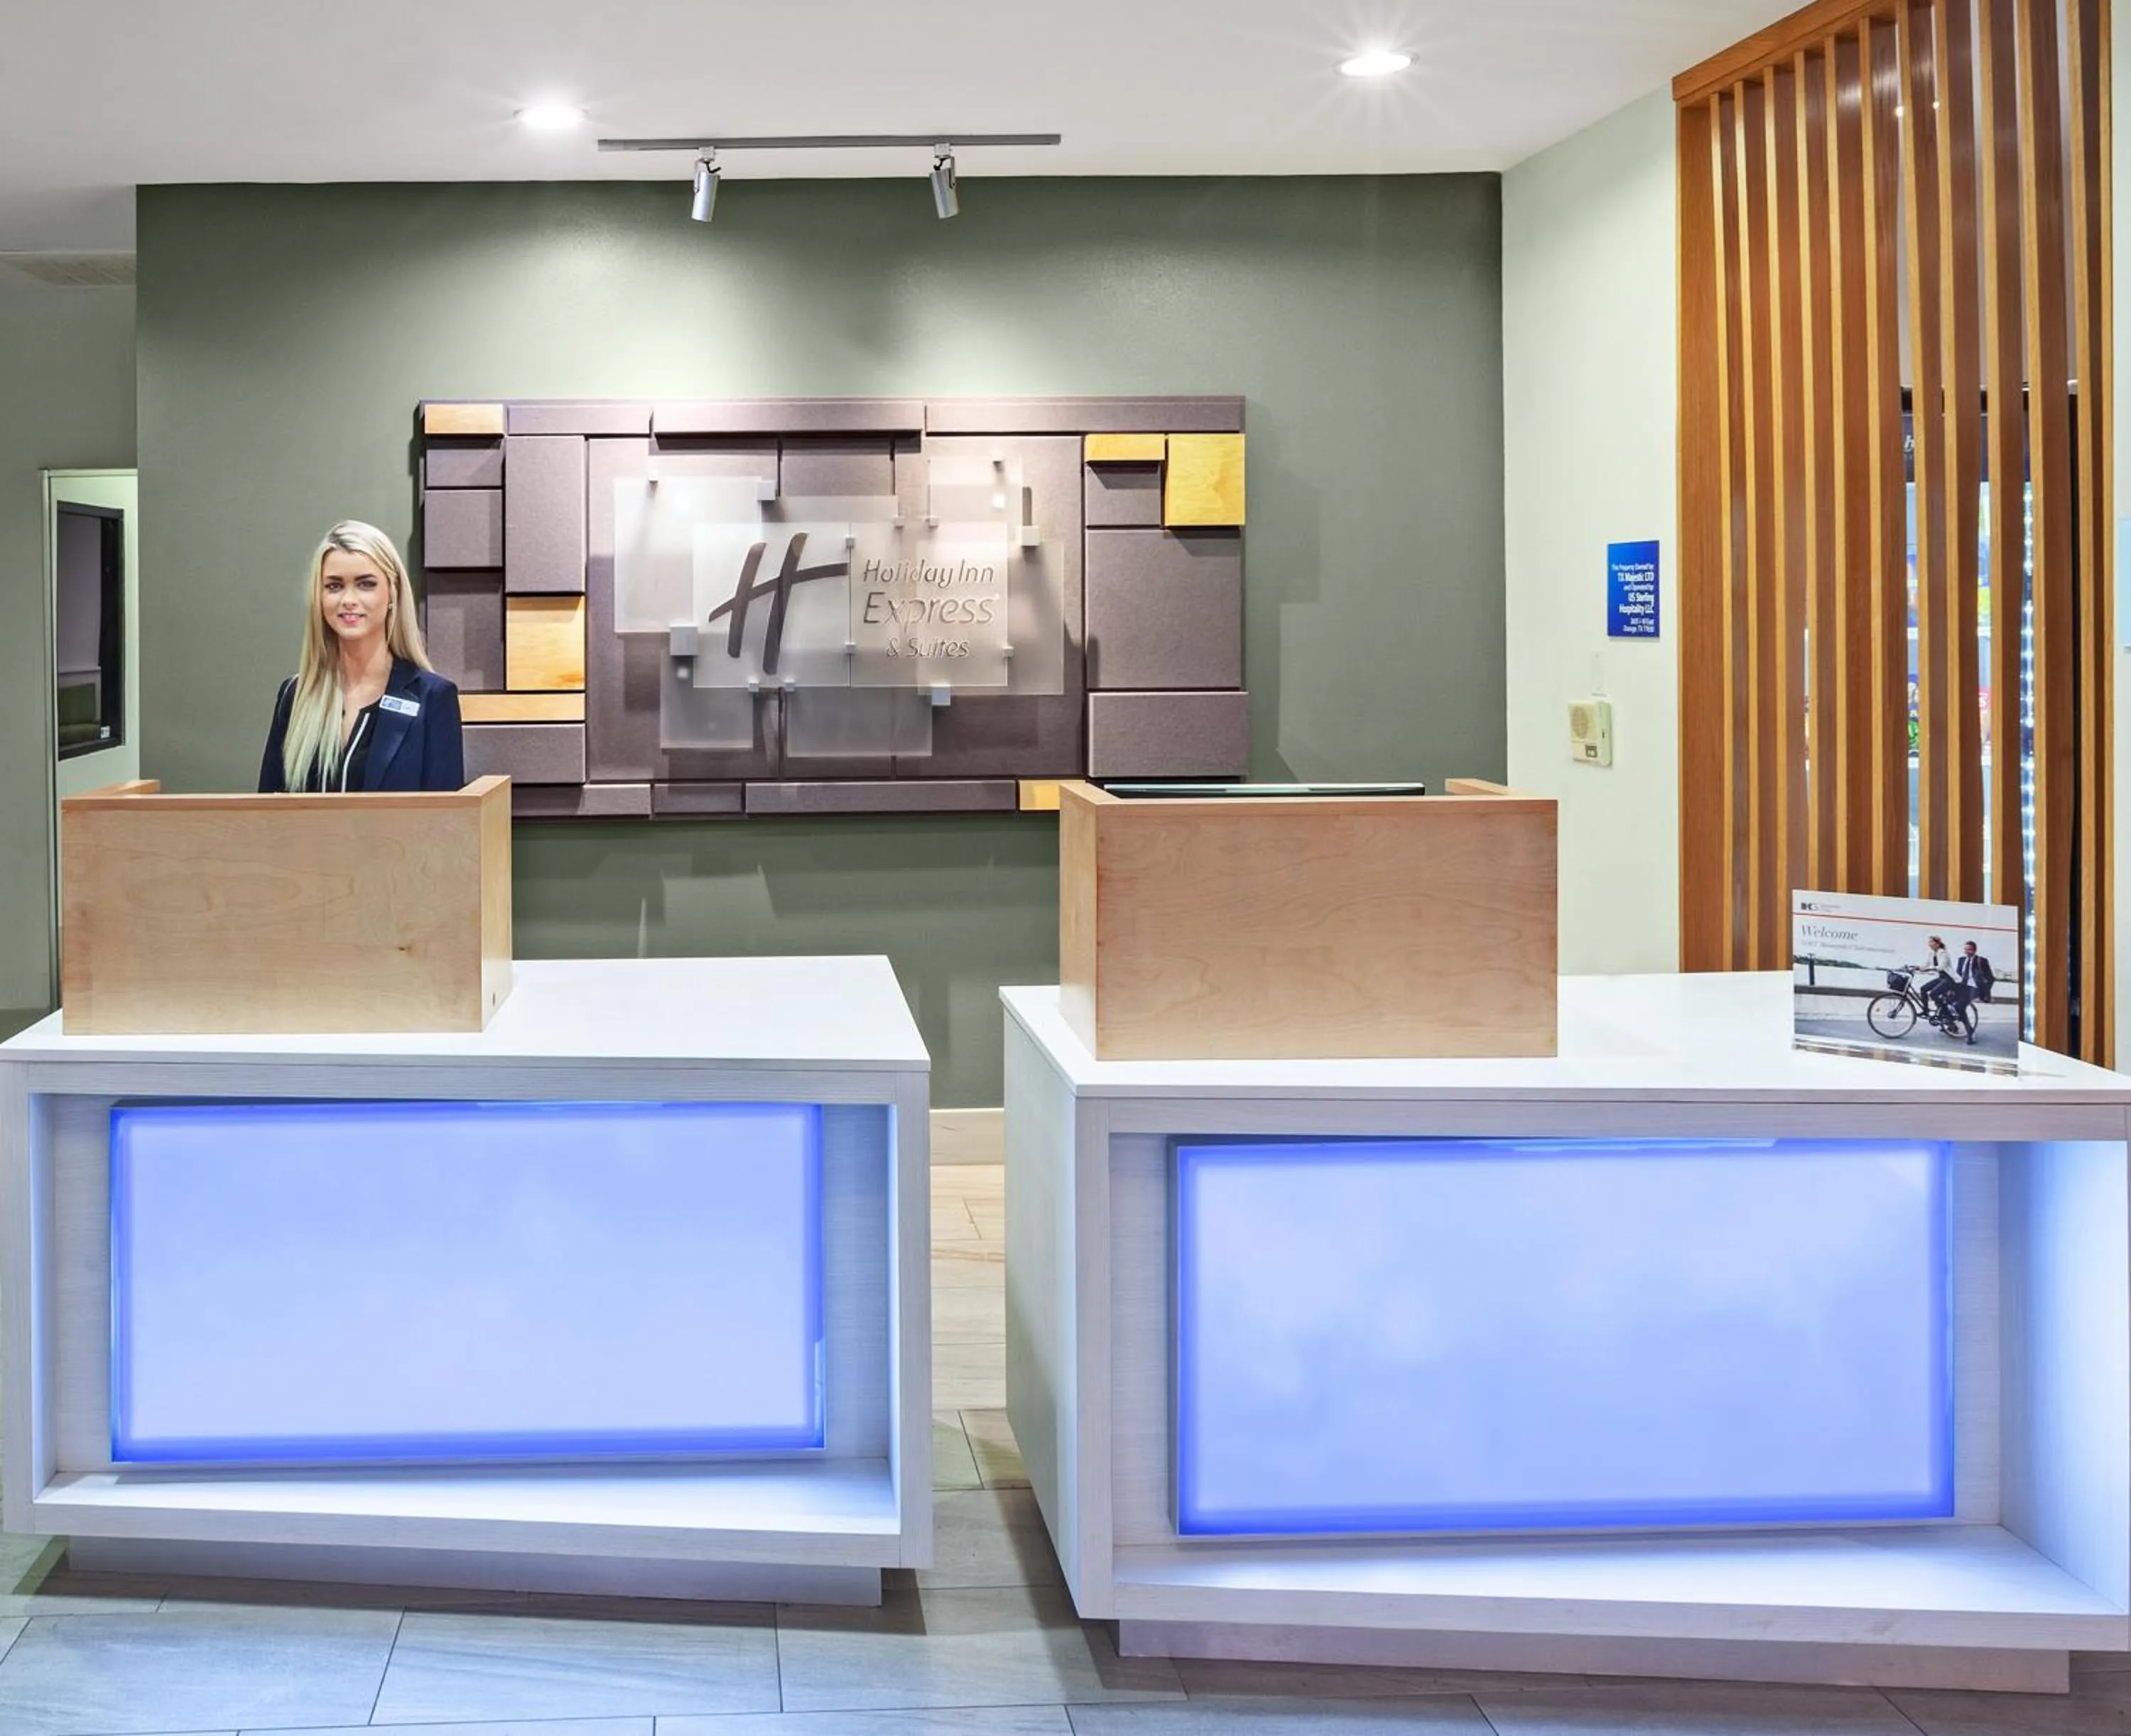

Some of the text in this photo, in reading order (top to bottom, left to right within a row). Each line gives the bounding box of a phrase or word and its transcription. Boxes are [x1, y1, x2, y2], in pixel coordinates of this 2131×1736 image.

[863, 558, 994, 589] Holiday Inn
[863, 592, 994, 634] Express
[886, 637, 970, 657] & Suites
[1801, 924, 1858, 941] Welcome
